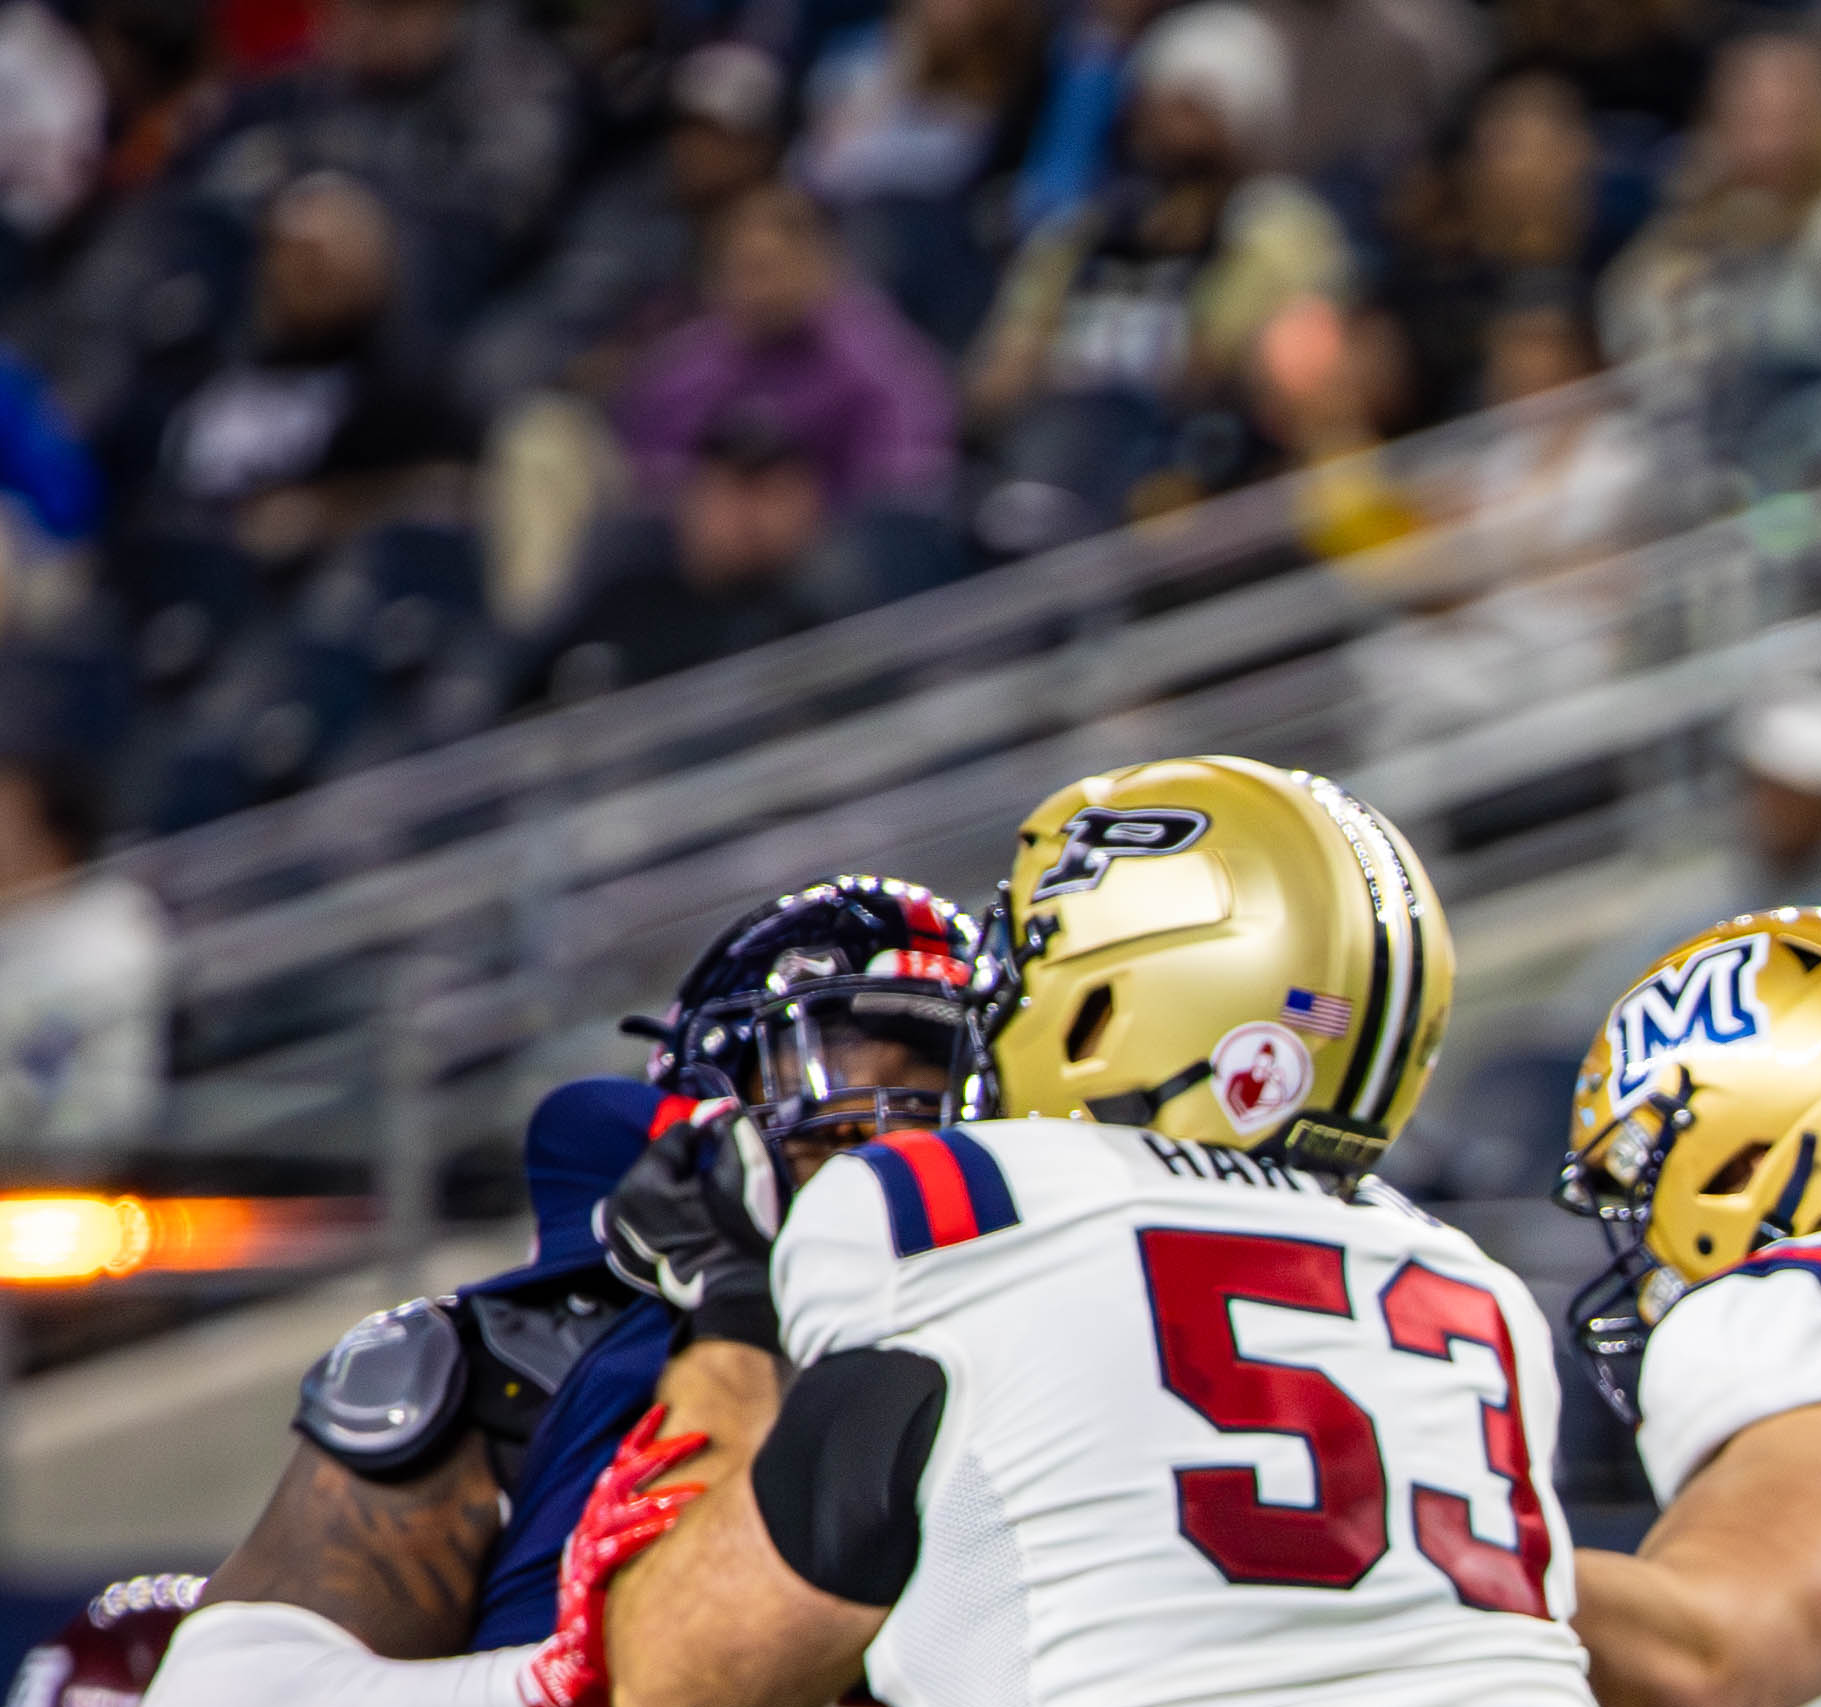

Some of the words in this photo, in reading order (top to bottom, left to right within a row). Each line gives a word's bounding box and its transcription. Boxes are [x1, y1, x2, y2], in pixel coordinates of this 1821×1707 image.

[1028, 806, 1212, 905] P
[1605, 931, 1771, 1118] M
[1135, 1225, 1558, 1622] 53
